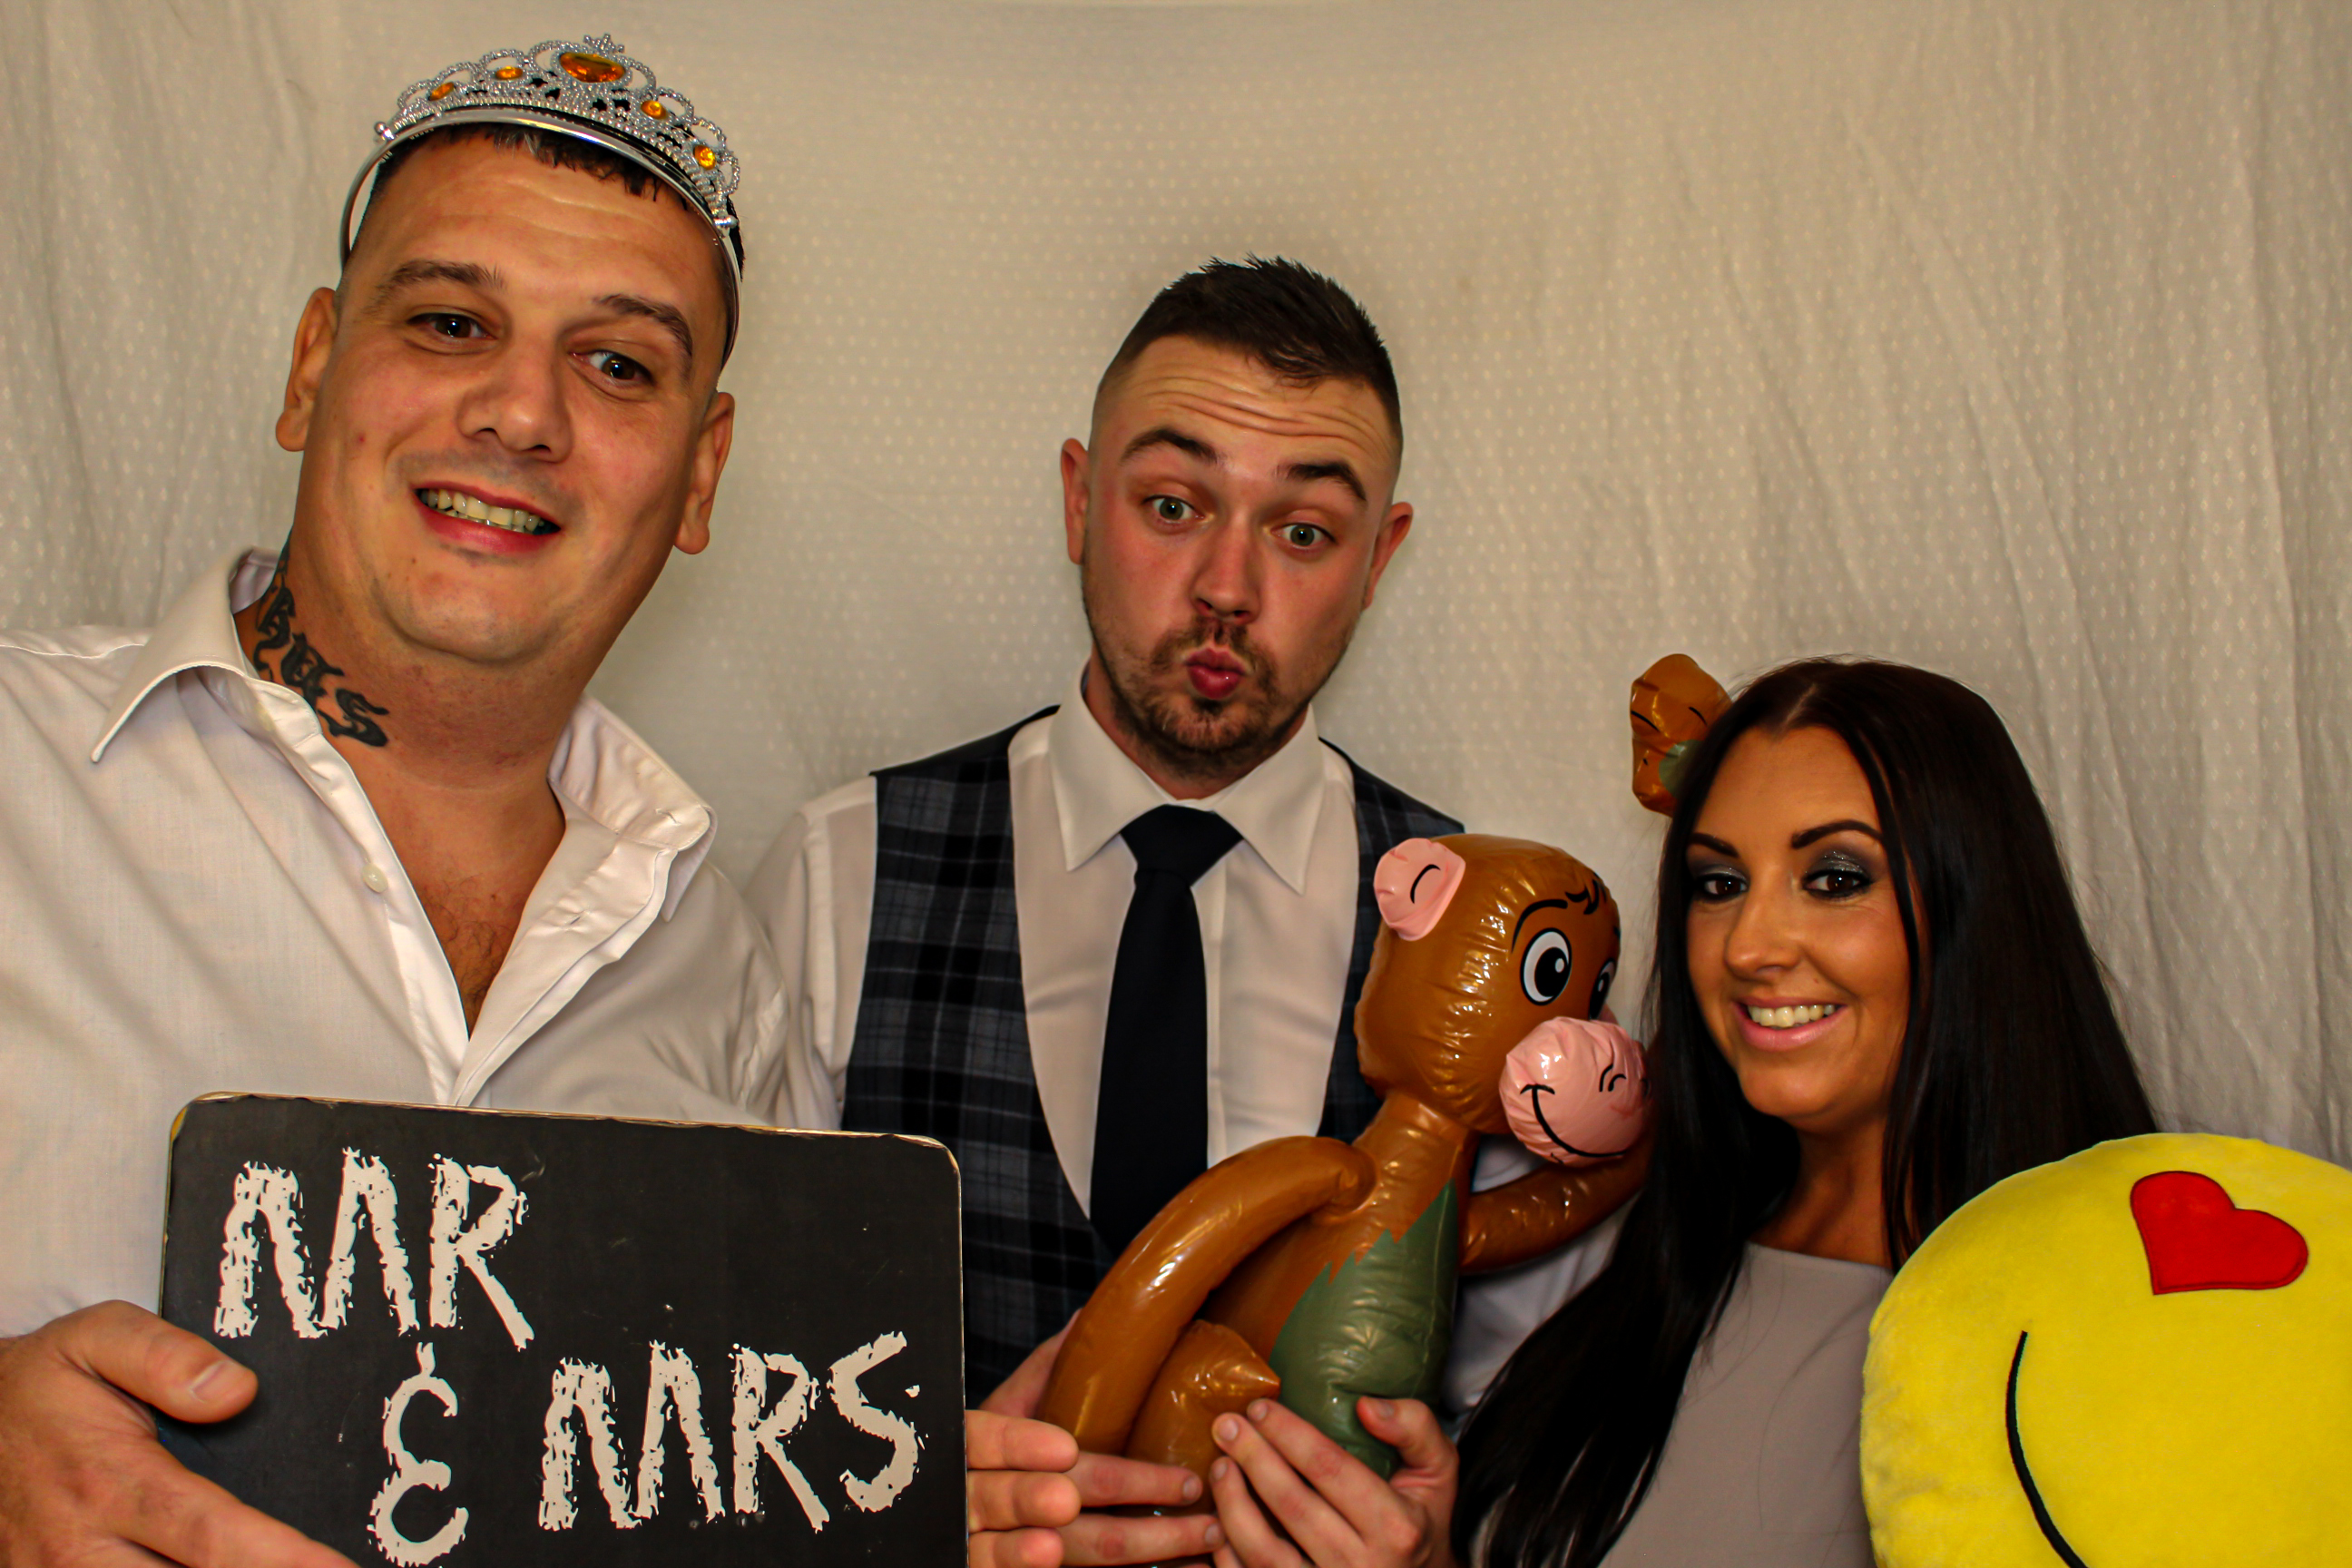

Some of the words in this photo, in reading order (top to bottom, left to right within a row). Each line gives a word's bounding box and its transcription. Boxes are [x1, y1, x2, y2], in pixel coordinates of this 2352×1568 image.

[214, 1147, 534, 1351] MR
[368, 1341, 469, 1568] &
[538, 1330, 920, 1534] MRS
